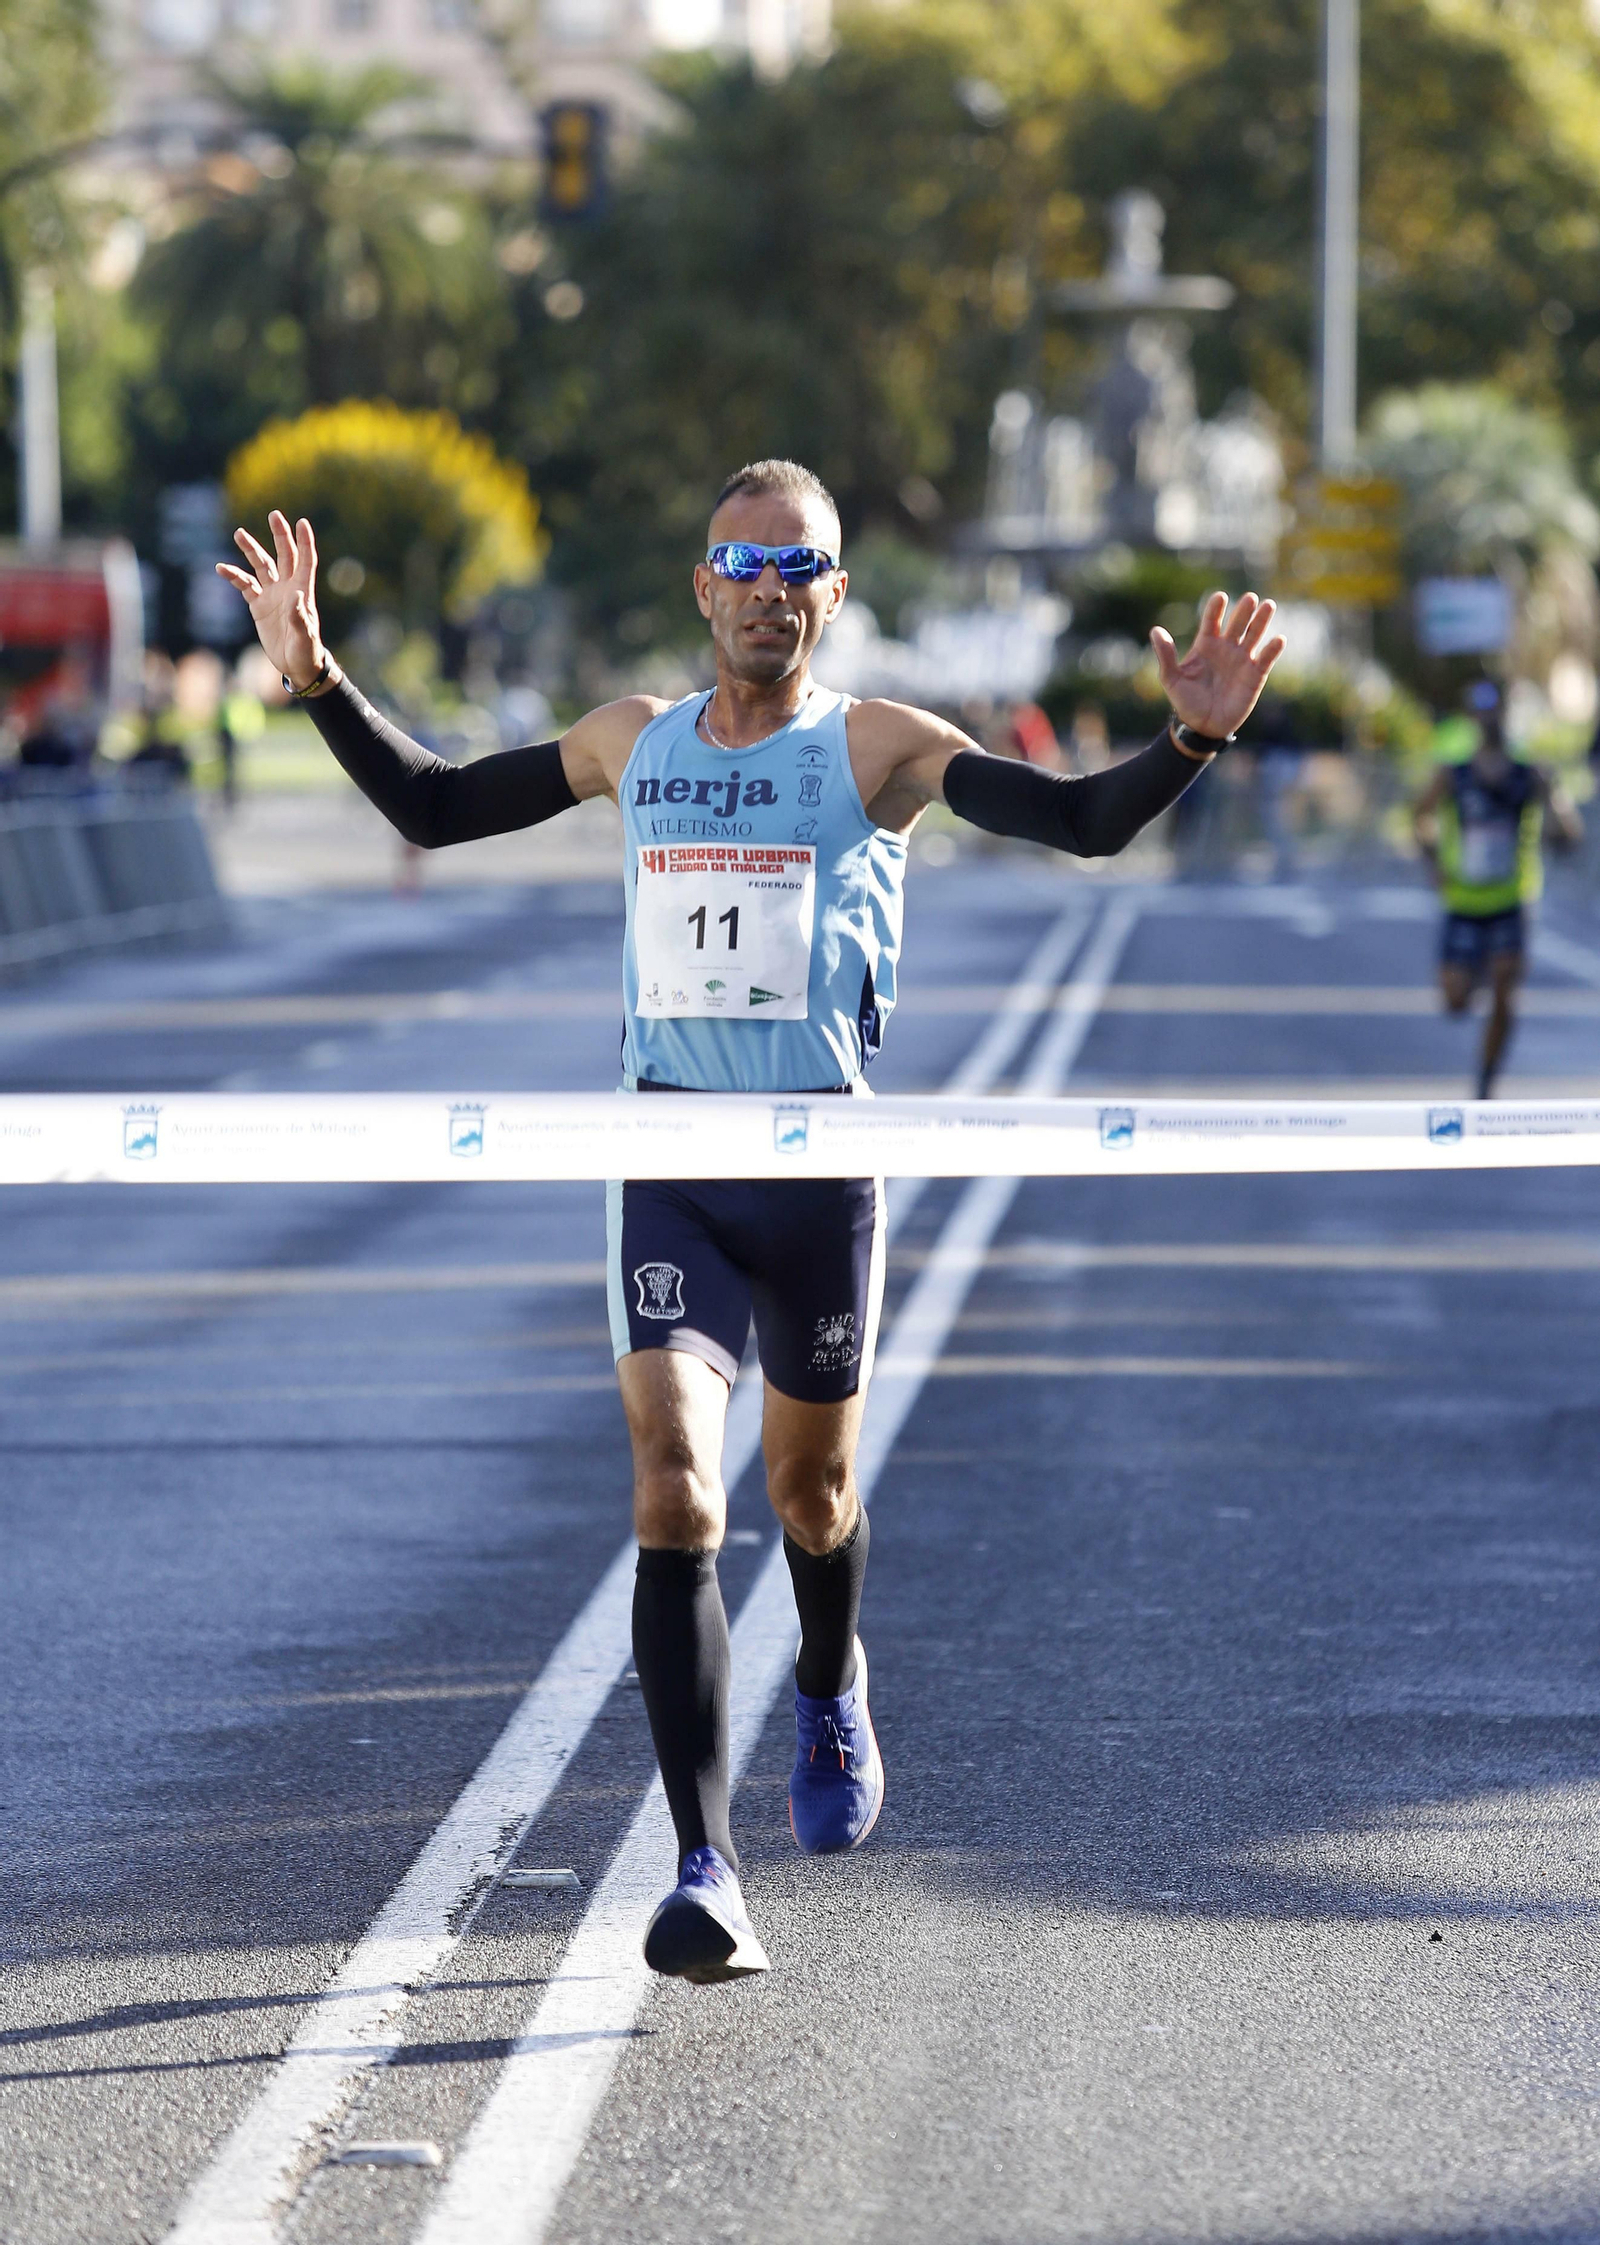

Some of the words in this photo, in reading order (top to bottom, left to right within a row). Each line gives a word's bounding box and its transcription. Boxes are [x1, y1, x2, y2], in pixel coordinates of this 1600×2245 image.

[634, 770, 778, 818] nerja
[648, 819, 753, 838] ATLETISMO
[642, 849, 667, 875] 41
[669, 848, 739, 863] CARRERA
[743, 851, 812, 865] URBANA
[669, 863, 708, 874] CIUDAD
[711, 863, 727, 873] DE
[731, 861, 785, 875] MÁLAGA
[748, 880, 803, 891] FEDERADO
[687, 904, 740, 951] 11
